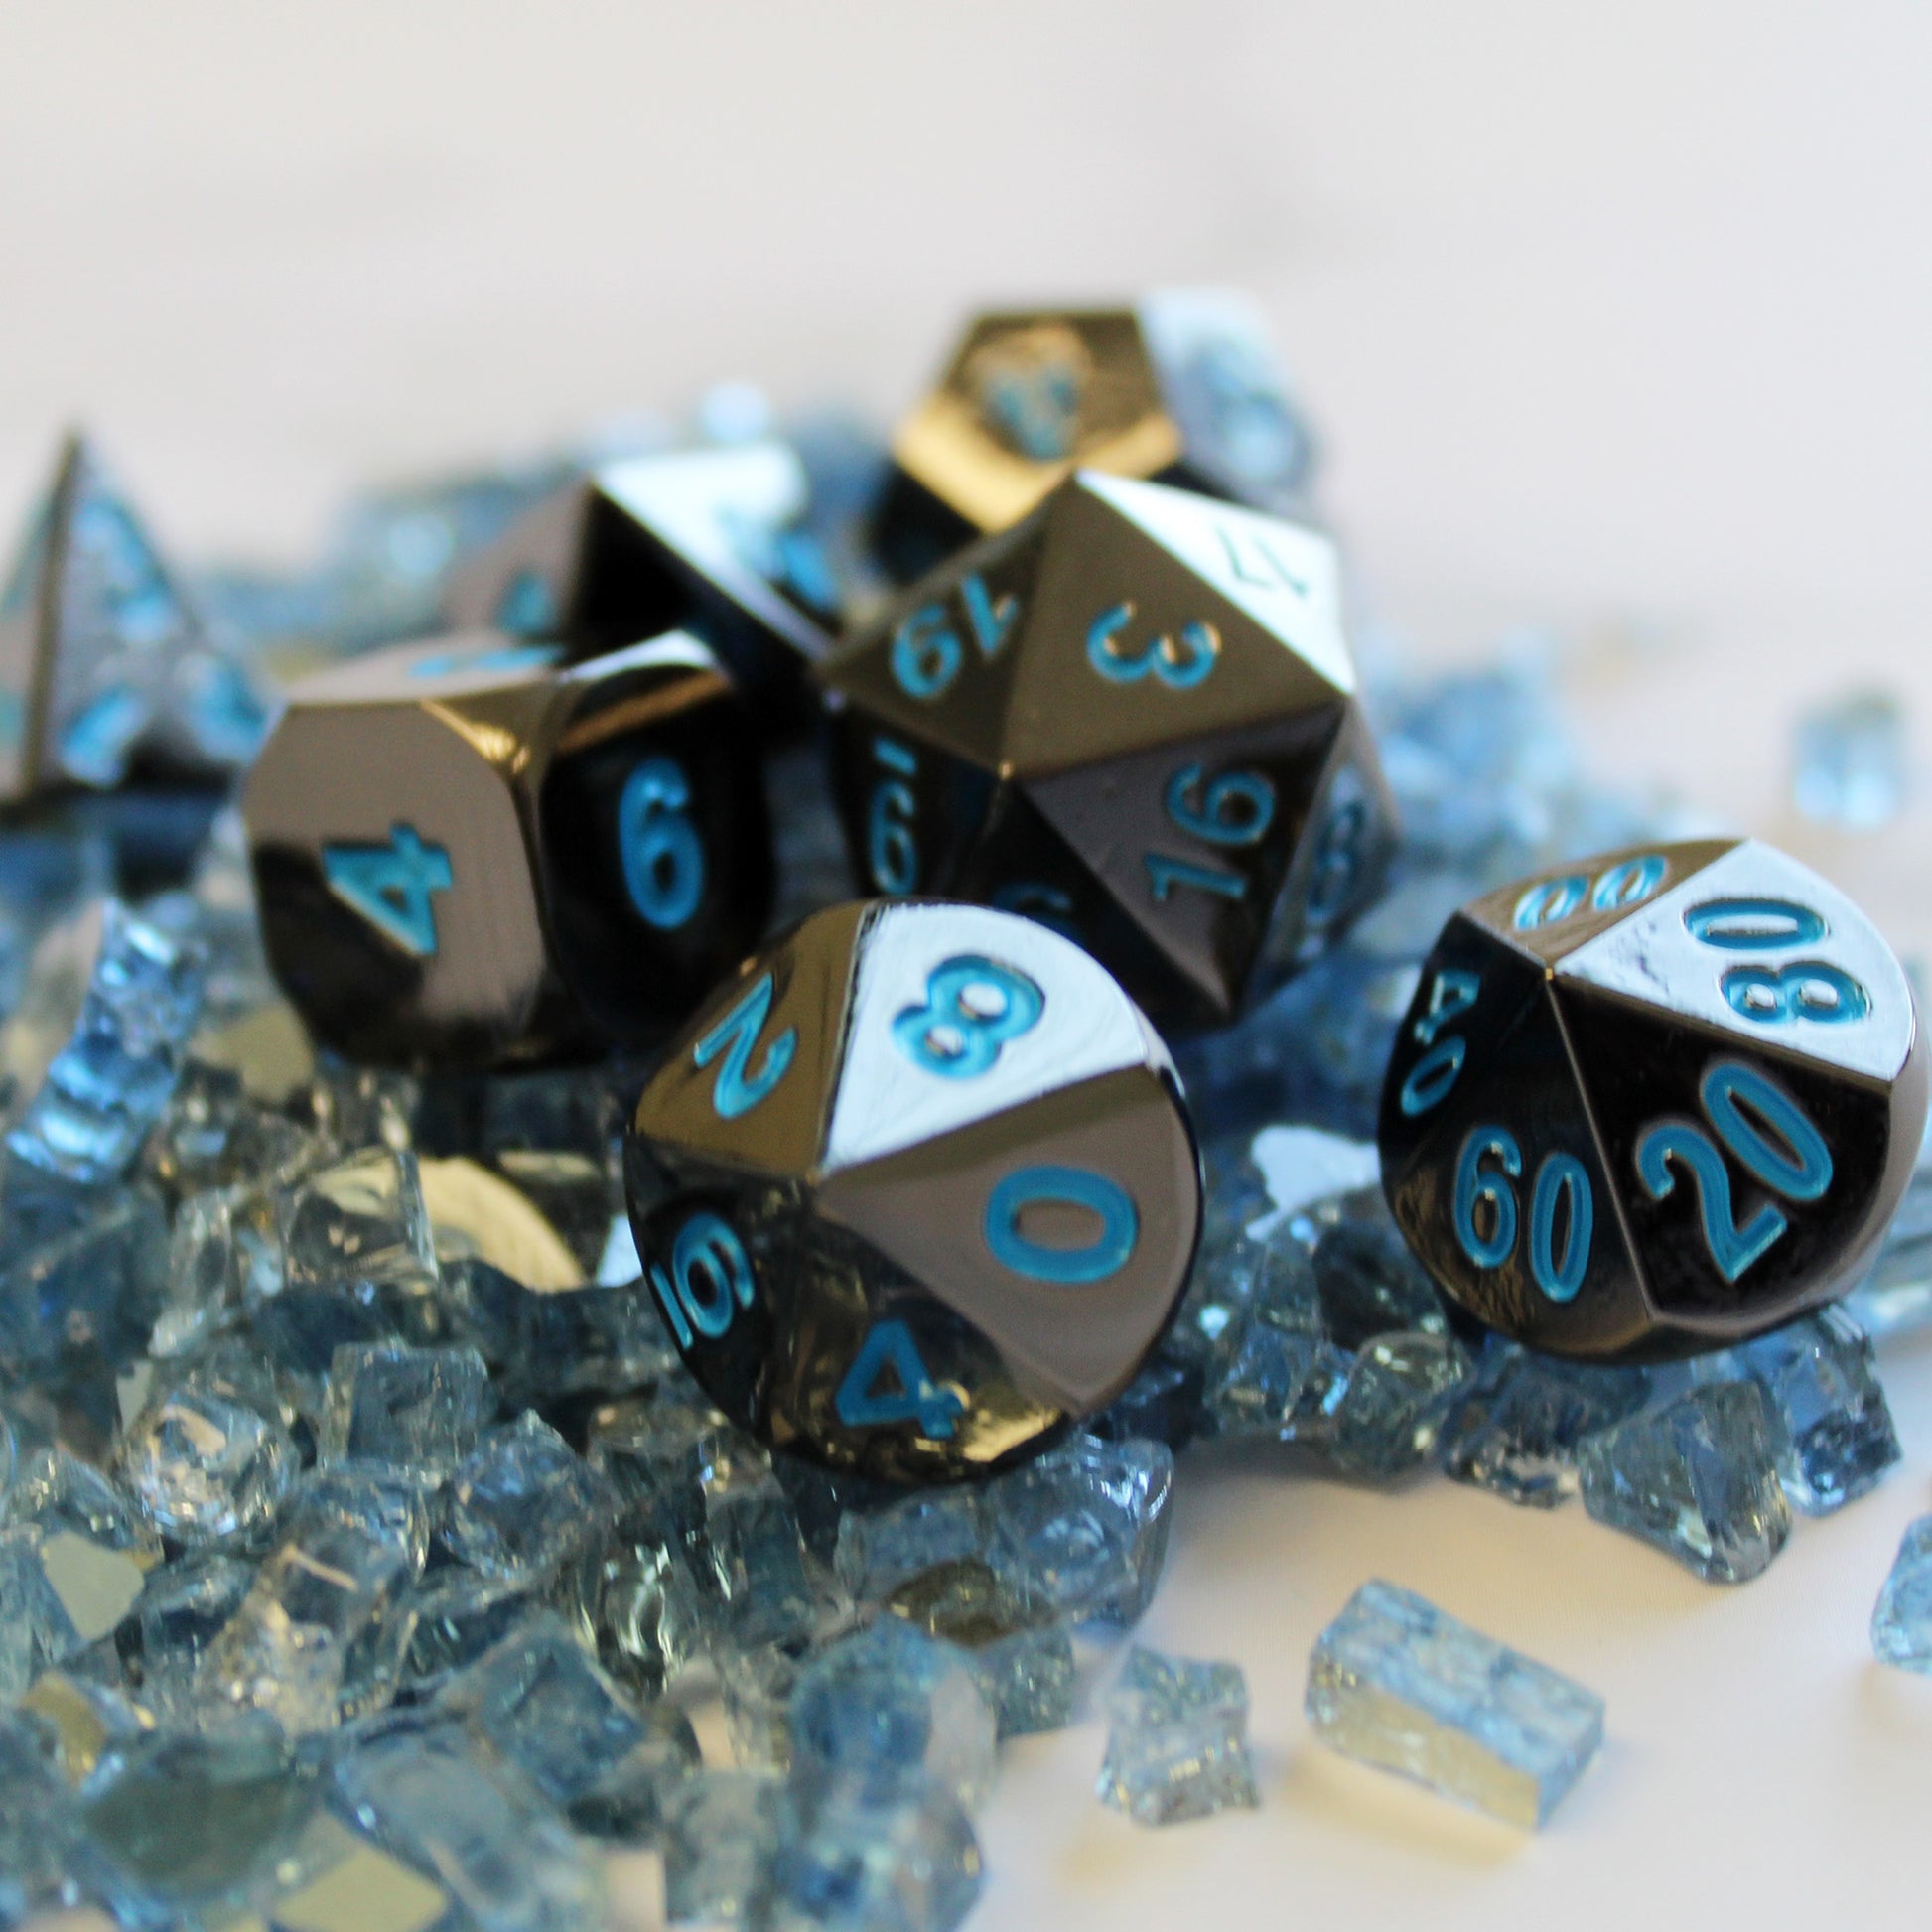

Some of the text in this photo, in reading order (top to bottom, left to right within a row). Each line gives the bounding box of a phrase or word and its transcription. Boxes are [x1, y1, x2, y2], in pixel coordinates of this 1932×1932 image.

[891, 571, 1019, 699] 19
[1086, 601, 1221, 688] 3
[322, 823, 453, 956] 4
[619, 756, 704, 929] 6
[1144, 764, 1274, 901] 16
[1515, 855, 1667, 930] 00
[891, 953, 1045, 1079] 8
[1683, 898, 1872, 1025] 80
[694, 973, 796, 1118] 2
[1400, 969, 1481, 1117] 40
[984, 1165, 1139, 1284] 0
[1453, 1125, 1593, 1303] 60
[1636, 1061, 1834, 1282] 20
[836, 1319, 966, 1440] 4
